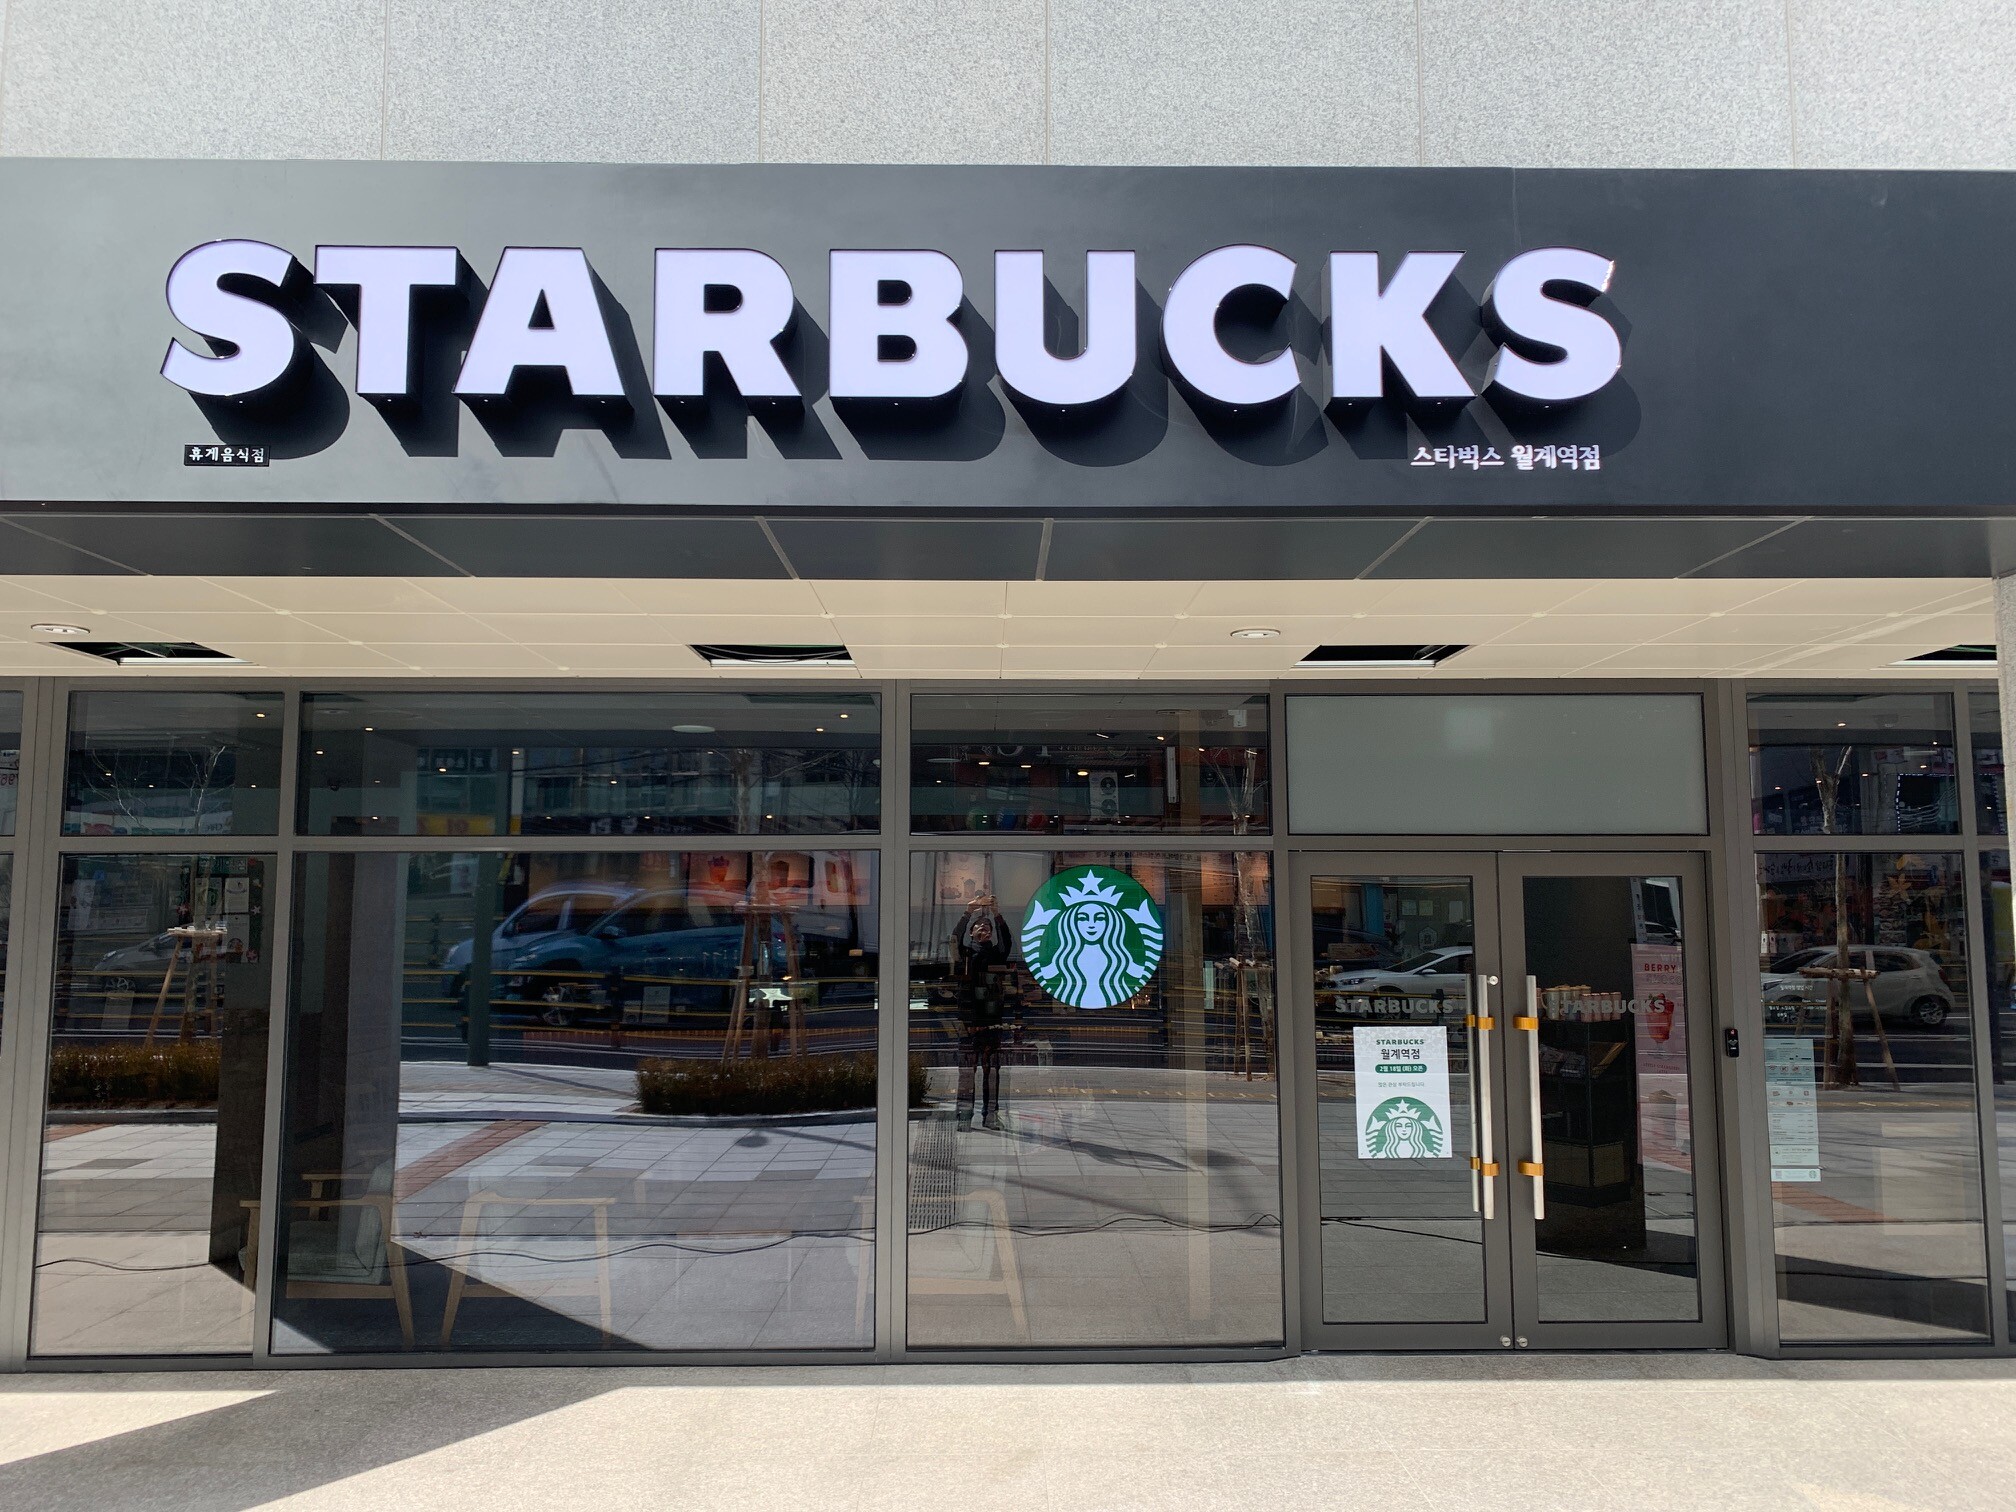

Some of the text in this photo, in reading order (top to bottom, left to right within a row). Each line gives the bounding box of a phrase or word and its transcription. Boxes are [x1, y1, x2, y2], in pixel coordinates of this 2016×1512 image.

[160, 238, 1623, 405] STARBUCKS
[188, 446, 265, 463] 휴게음식점
[1410, 444, 1601, 471] 스타벅스 월계역점
[1644, 963, 1676, 974] BERRY
[1335, 997, 1454, 1014] STARBUCKS
[1381, 1048, 1420, 1060] 월계역점
